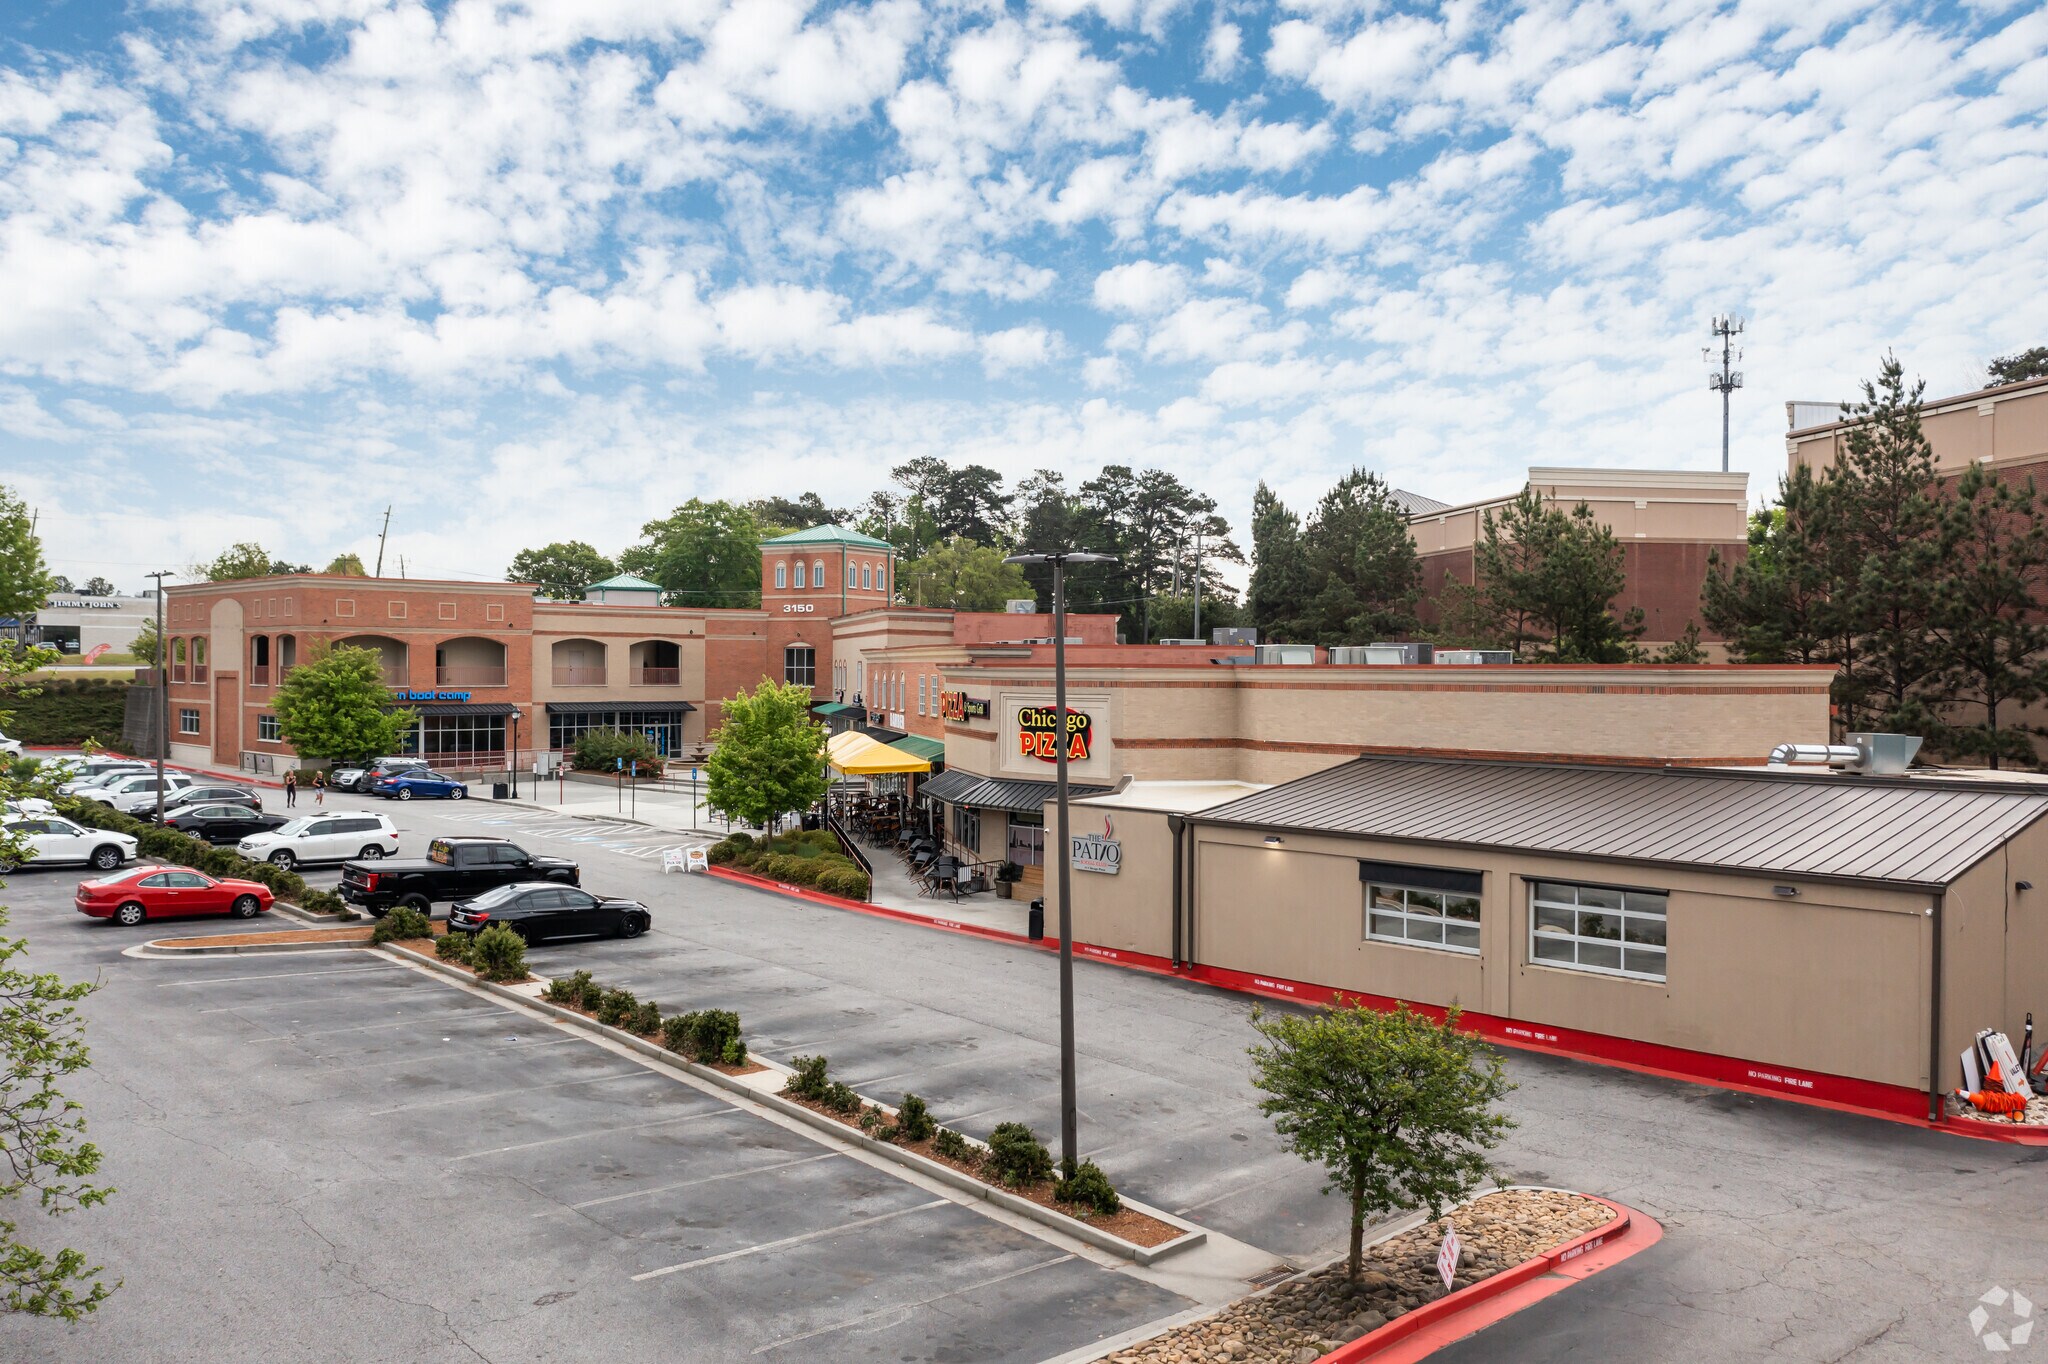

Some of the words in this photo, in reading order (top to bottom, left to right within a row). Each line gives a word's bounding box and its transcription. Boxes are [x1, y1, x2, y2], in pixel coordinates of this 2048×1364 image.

[53, 600, 87, 608] JIMMY
[89, 601, 122, 609] JOHN'S
[783, 604, 814, 613] 3150
[408, 689, 436, 700] boot
[438, 691, 472, 703] camp
[941, 691, 965, 721] PIZZA
[1019, 708, 1088, 732] Chicgo
[1019, 732, 1087, 758] PIZA
[1088, 833, 1101, 842] THE
[1072, 840, 1119, 863] PATIO
[1748, 1070, 1757, 1078] NO
[1757, 1072, 1782, 1083] PARKING
[1784, 1077, 1798, 1086] FIRE
[1798, 1079, 1813, 1089] LANE
[2010, 1064, 2021, 1076] VALET
[1560, 1252, 1567, 1262] NO
[1566, 1244, 1584, 1260] PARKING
[1584, 1240, 1594, 1253] FIRE
[1593, 1236, 1604, 1248] LANE
